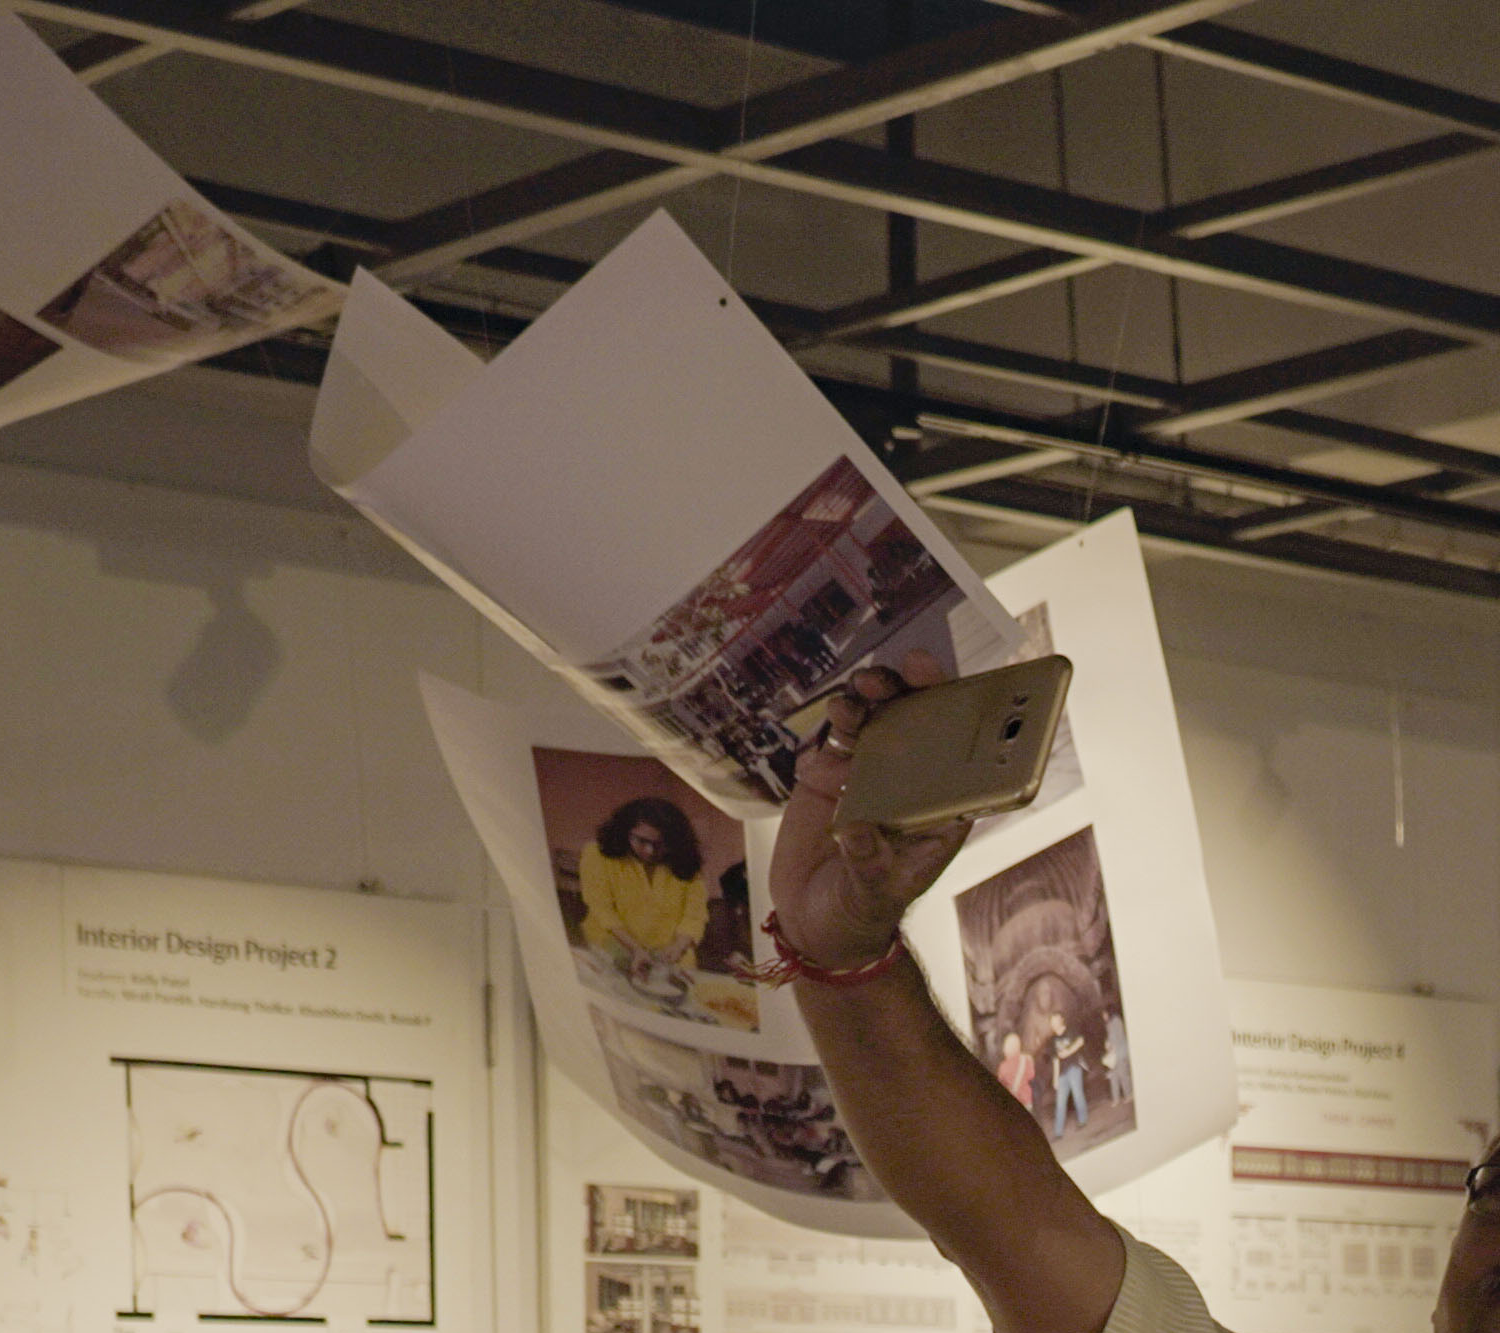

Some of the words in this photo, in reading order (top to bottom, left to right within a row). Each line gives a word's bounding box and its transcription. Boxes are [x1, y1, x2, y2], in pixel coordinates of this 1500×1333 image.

[76, 922, 160, 952] Interior
[166, 930, 240, 965] Design
[245, 939, 320, 971] Project
[325, 946, 338, 970] 2
[1231, 1029, 1285, 1051] Interior
[1288, 1034, 1337, 1060] Design
[1342, 1038, 1394, 1063] Project
